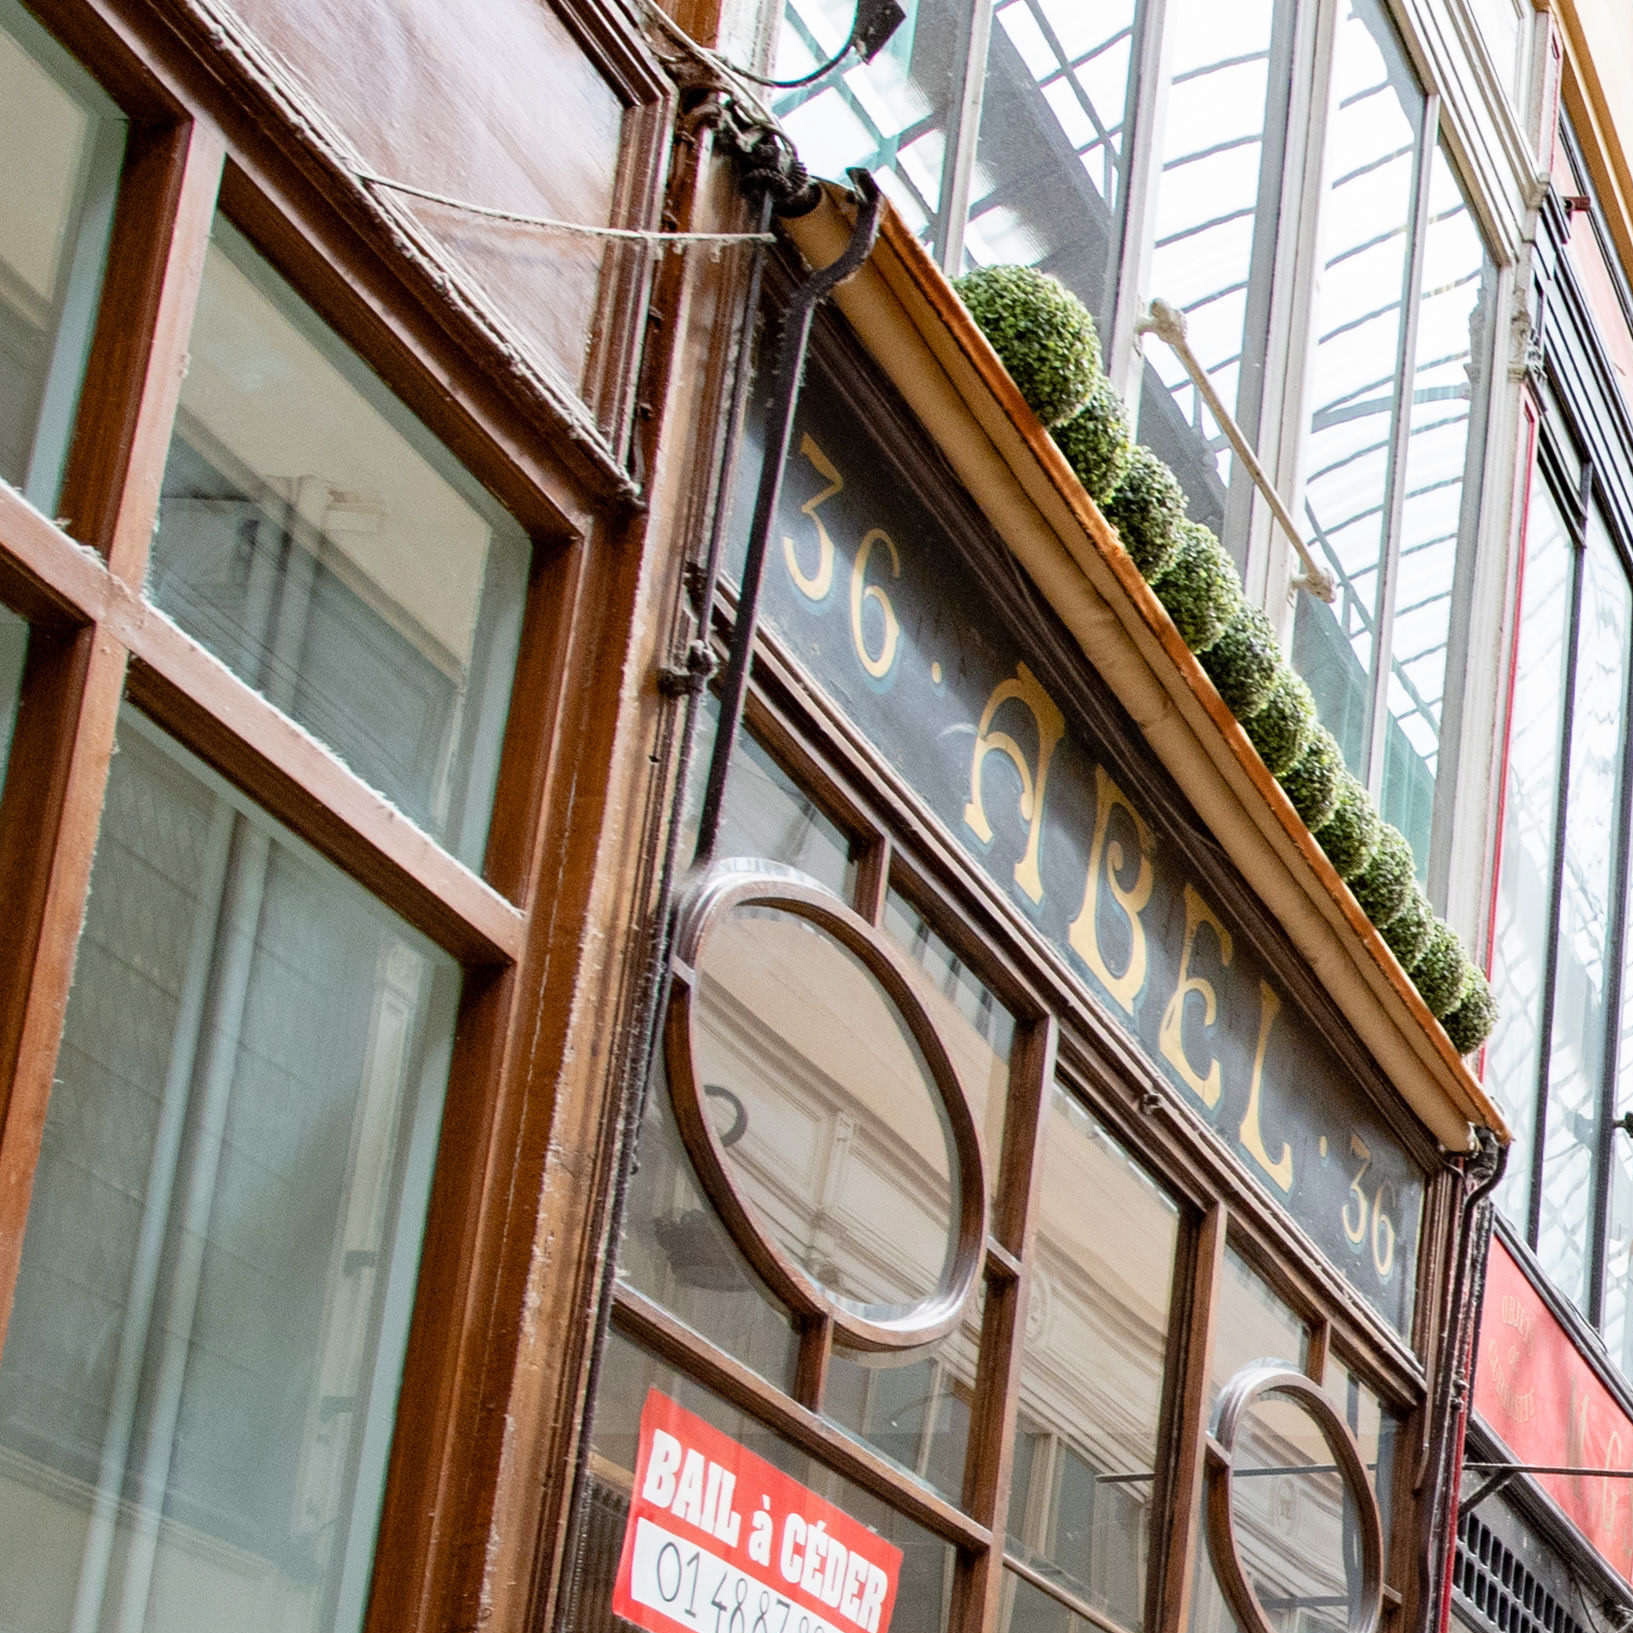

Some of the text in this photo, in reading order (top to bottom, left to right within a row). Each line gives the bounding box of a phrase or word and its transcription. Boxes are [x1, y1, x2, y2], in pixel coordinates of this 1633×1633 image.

[783, 432, 1396, 1279] 36 ABEL 36
[642, 1428, 742, 1548] BAIL
[748, 1494, 774, 1567] à
